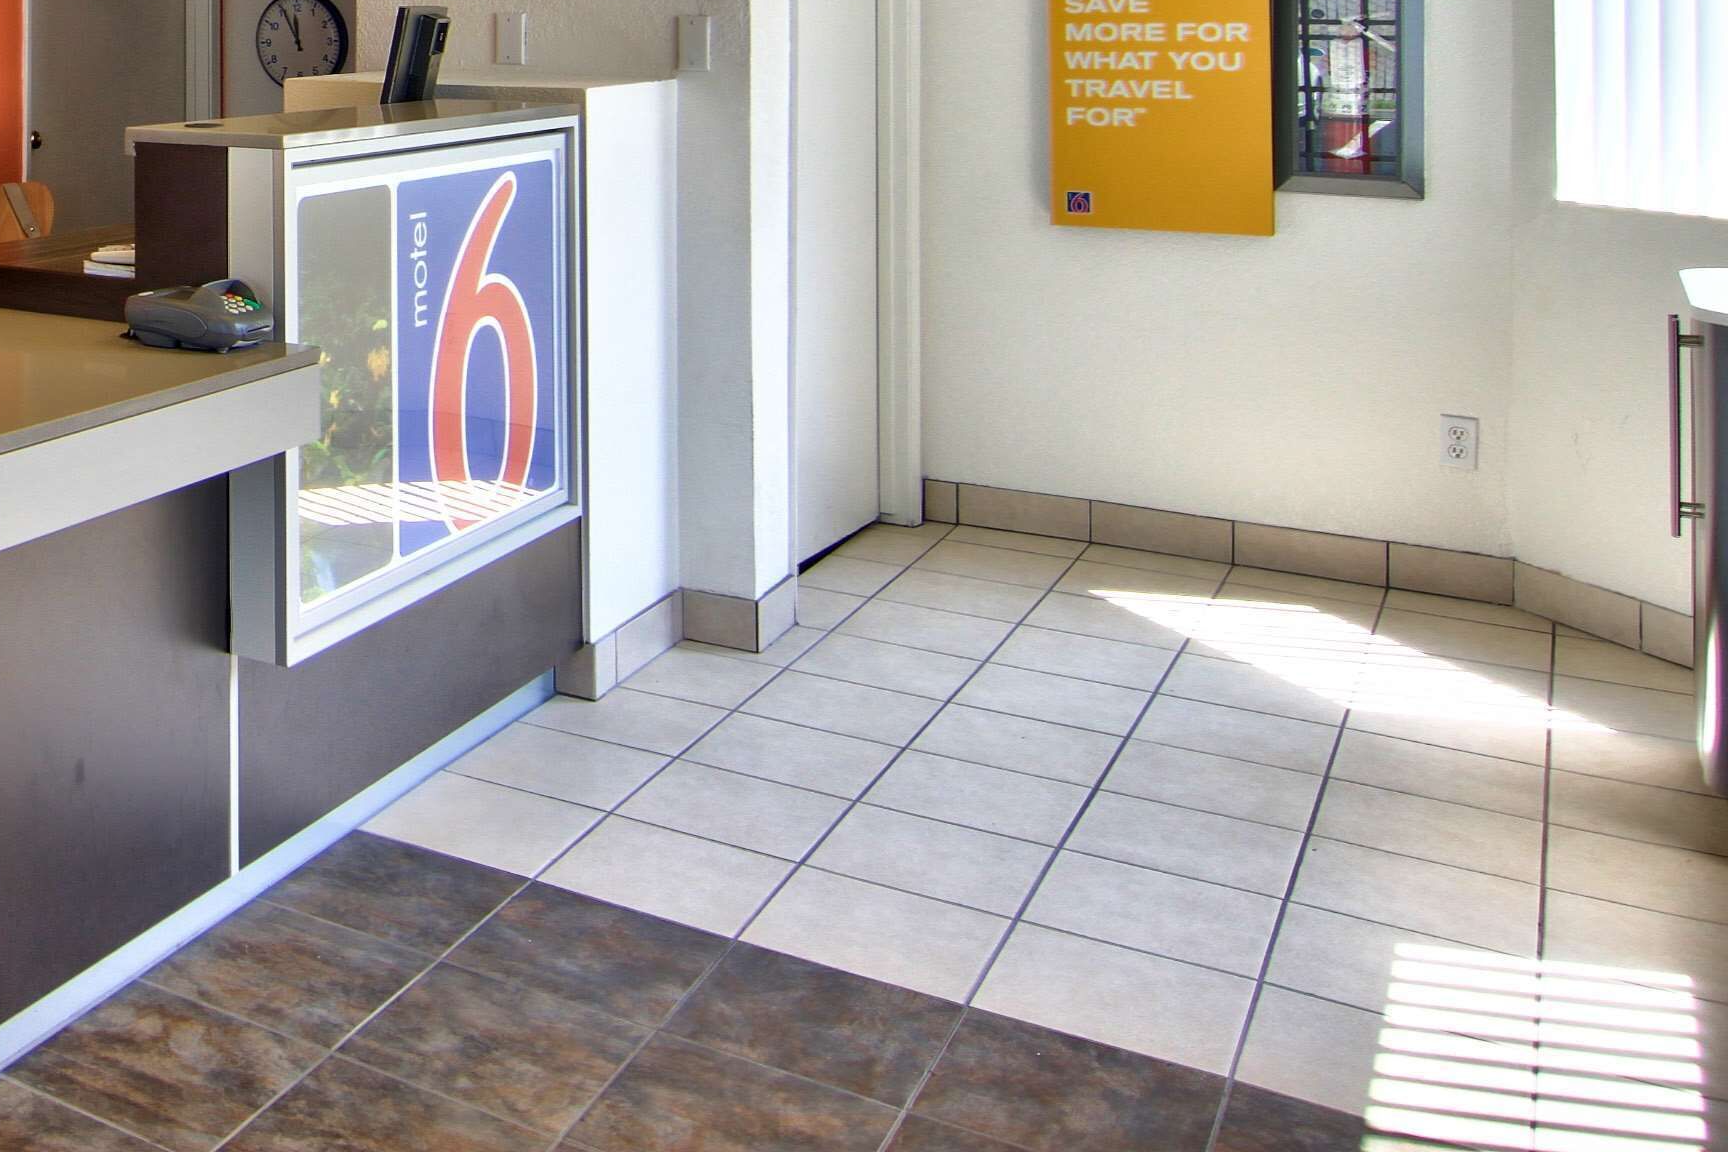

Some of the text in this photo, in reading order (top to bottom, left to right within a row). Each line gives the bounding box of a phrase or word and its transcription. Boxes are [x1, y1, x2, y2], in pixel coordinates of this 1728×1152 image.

[271, 22, 279, 30] 10
[1065, 22, 1249, 42] MORE FOR
[1065, 51, 1243, 71] WHAT YOU
[1065, 80, 1192, 99] TRAVEL
[409, 211, 429, 328] motel
[428, 170, 538, 537] 6
